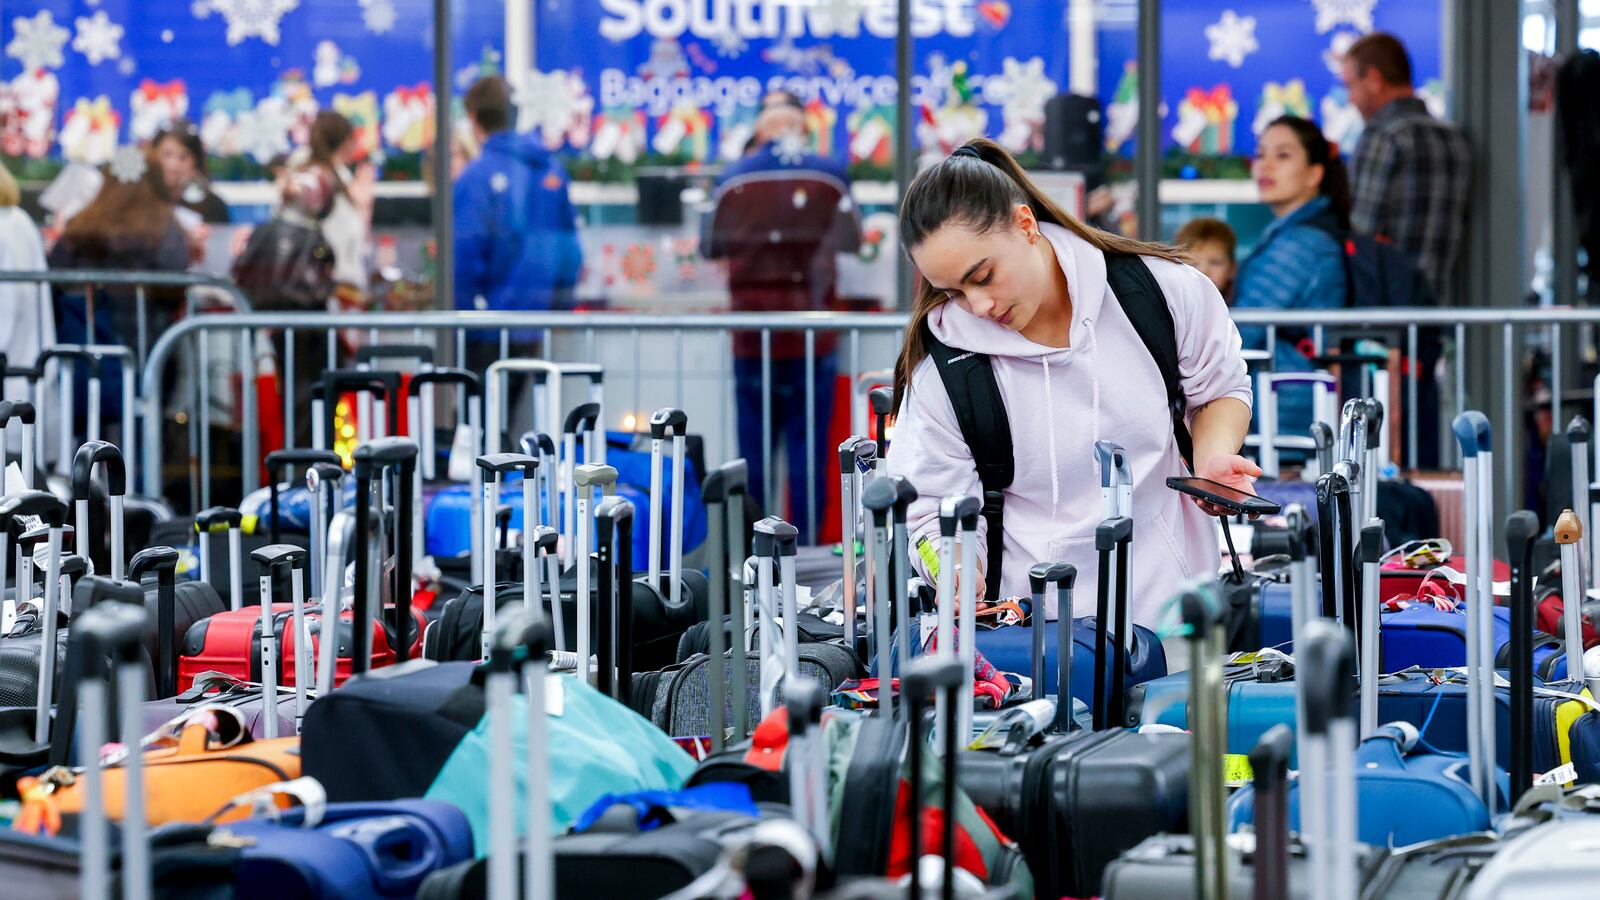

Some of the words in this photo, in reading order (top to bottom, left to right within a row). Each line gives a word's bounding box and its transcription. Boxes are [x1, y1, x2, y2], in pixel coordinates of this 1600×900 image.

[600, 0, 975, 40] Southwest
[601, 68, 761, 117] Baggage
[905, 66, 1011, 106] offce
